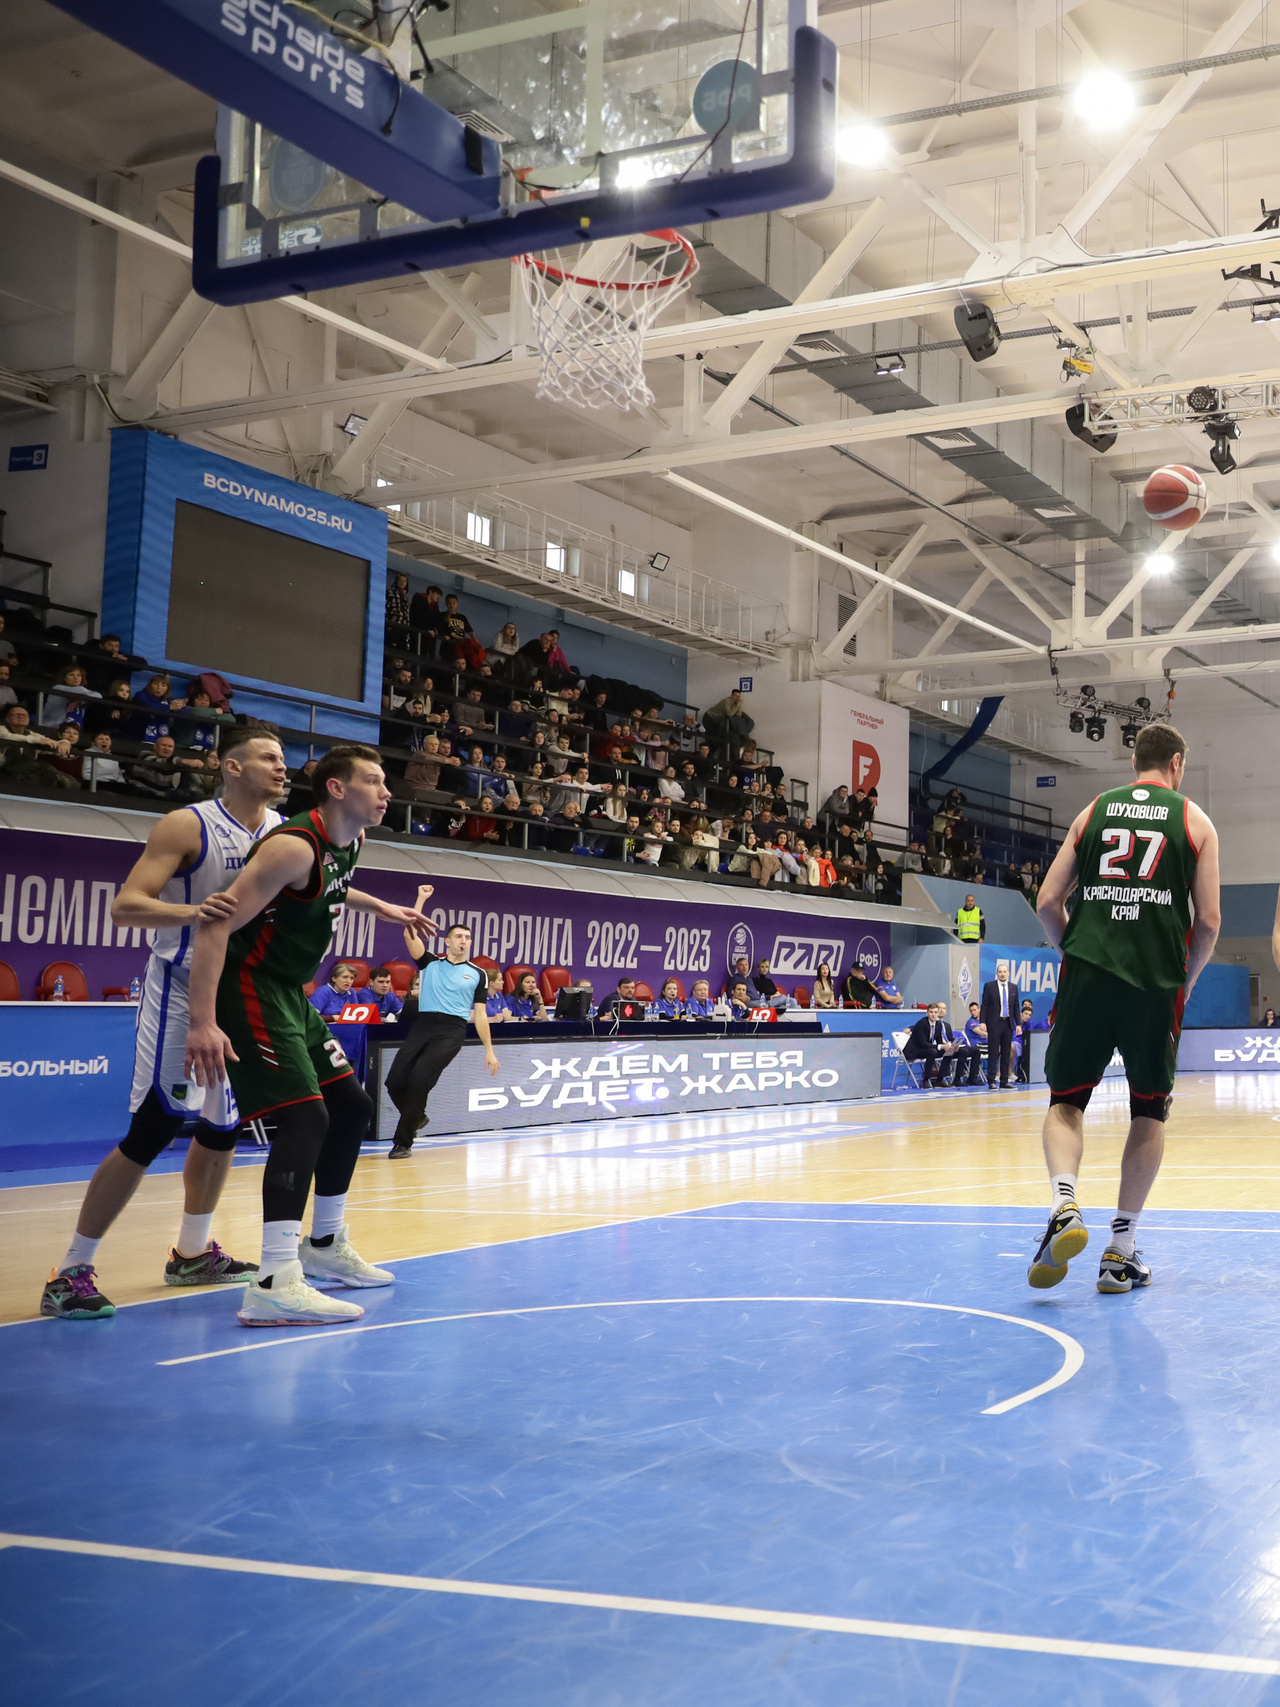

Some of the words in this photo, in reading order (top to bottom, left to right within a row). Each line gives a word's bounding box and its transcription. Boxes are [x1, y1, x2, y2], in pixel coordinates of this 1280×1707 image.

[237, 0, 365, 85] chelde
[203, 472, 353, 533] BCDYNAMO25.RU
[1106, 802, 1169, 821] ШУХОВЦОВ
[1099, 828, 1168, 880] 27
[1083, 885, 1172, 905] КРАСНОДАРСКИЙ
[1111, 904, 1140, 920] КРАЙ
[773, 941, 841, 971] PARI
[860, 953, 878, 967] РФБ
[342, 1006, 370, 1022] 5
[0, 1056, 109, 1078] БОЛЬНЫЙ
[529, 1053, 689, 1080] ЖДЕМ
[703, 1050, 804, 1070] ТЕБЯ
[680, 1069, 840, 1096] ЖАРКО
